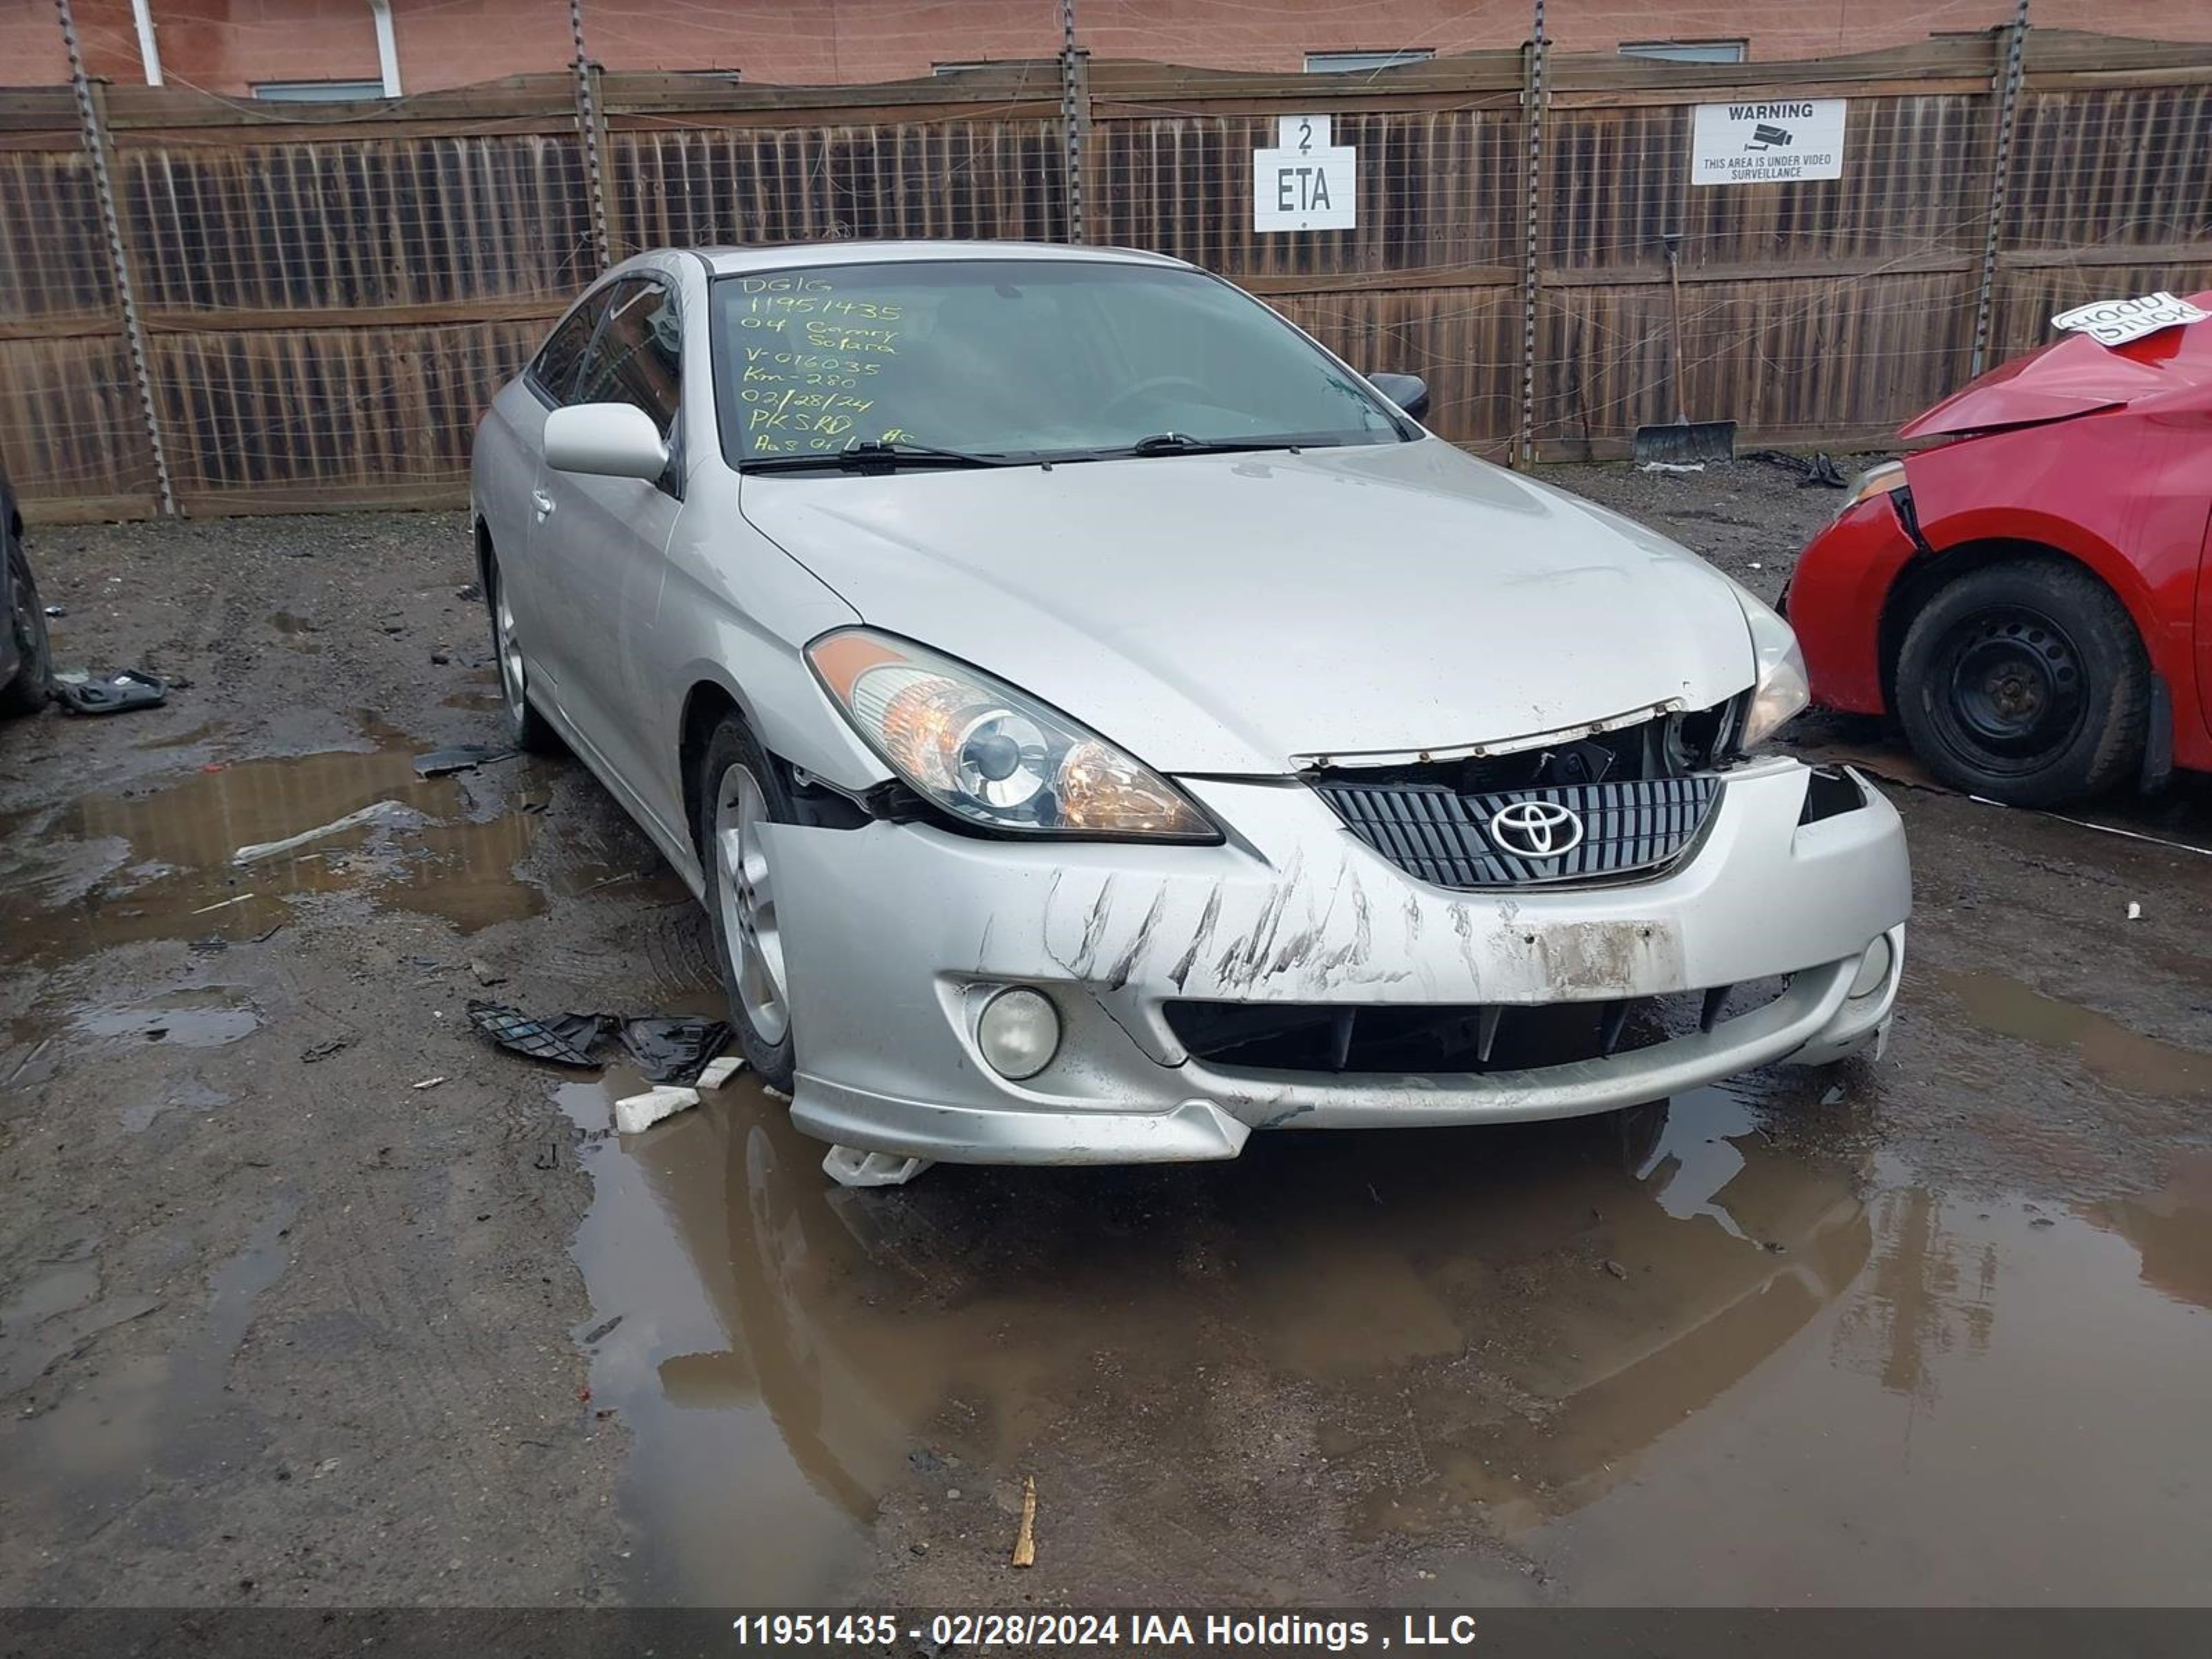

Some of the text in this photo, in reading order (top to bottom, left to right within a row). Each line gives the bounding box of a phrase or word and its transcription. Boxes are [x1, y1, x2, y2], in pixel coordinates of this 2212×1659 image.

[1729, 104, 1813, 120] WARNING
[1298, 124, 1313, 149] 2
[1704, 153, 1831, 169] THIS AREA IS UNDER VIDEO
[1732, 167, 1801, 180] SURVEILLANCE
[1278, 167, 1330, 212] ETA
[751, 297, 901, 321] 11951435
[741, 317, 898, 344] 04 Camry
[2096, 306, 2200, 339] STUCK
[741, 389, 874, 413] 02/28/24
